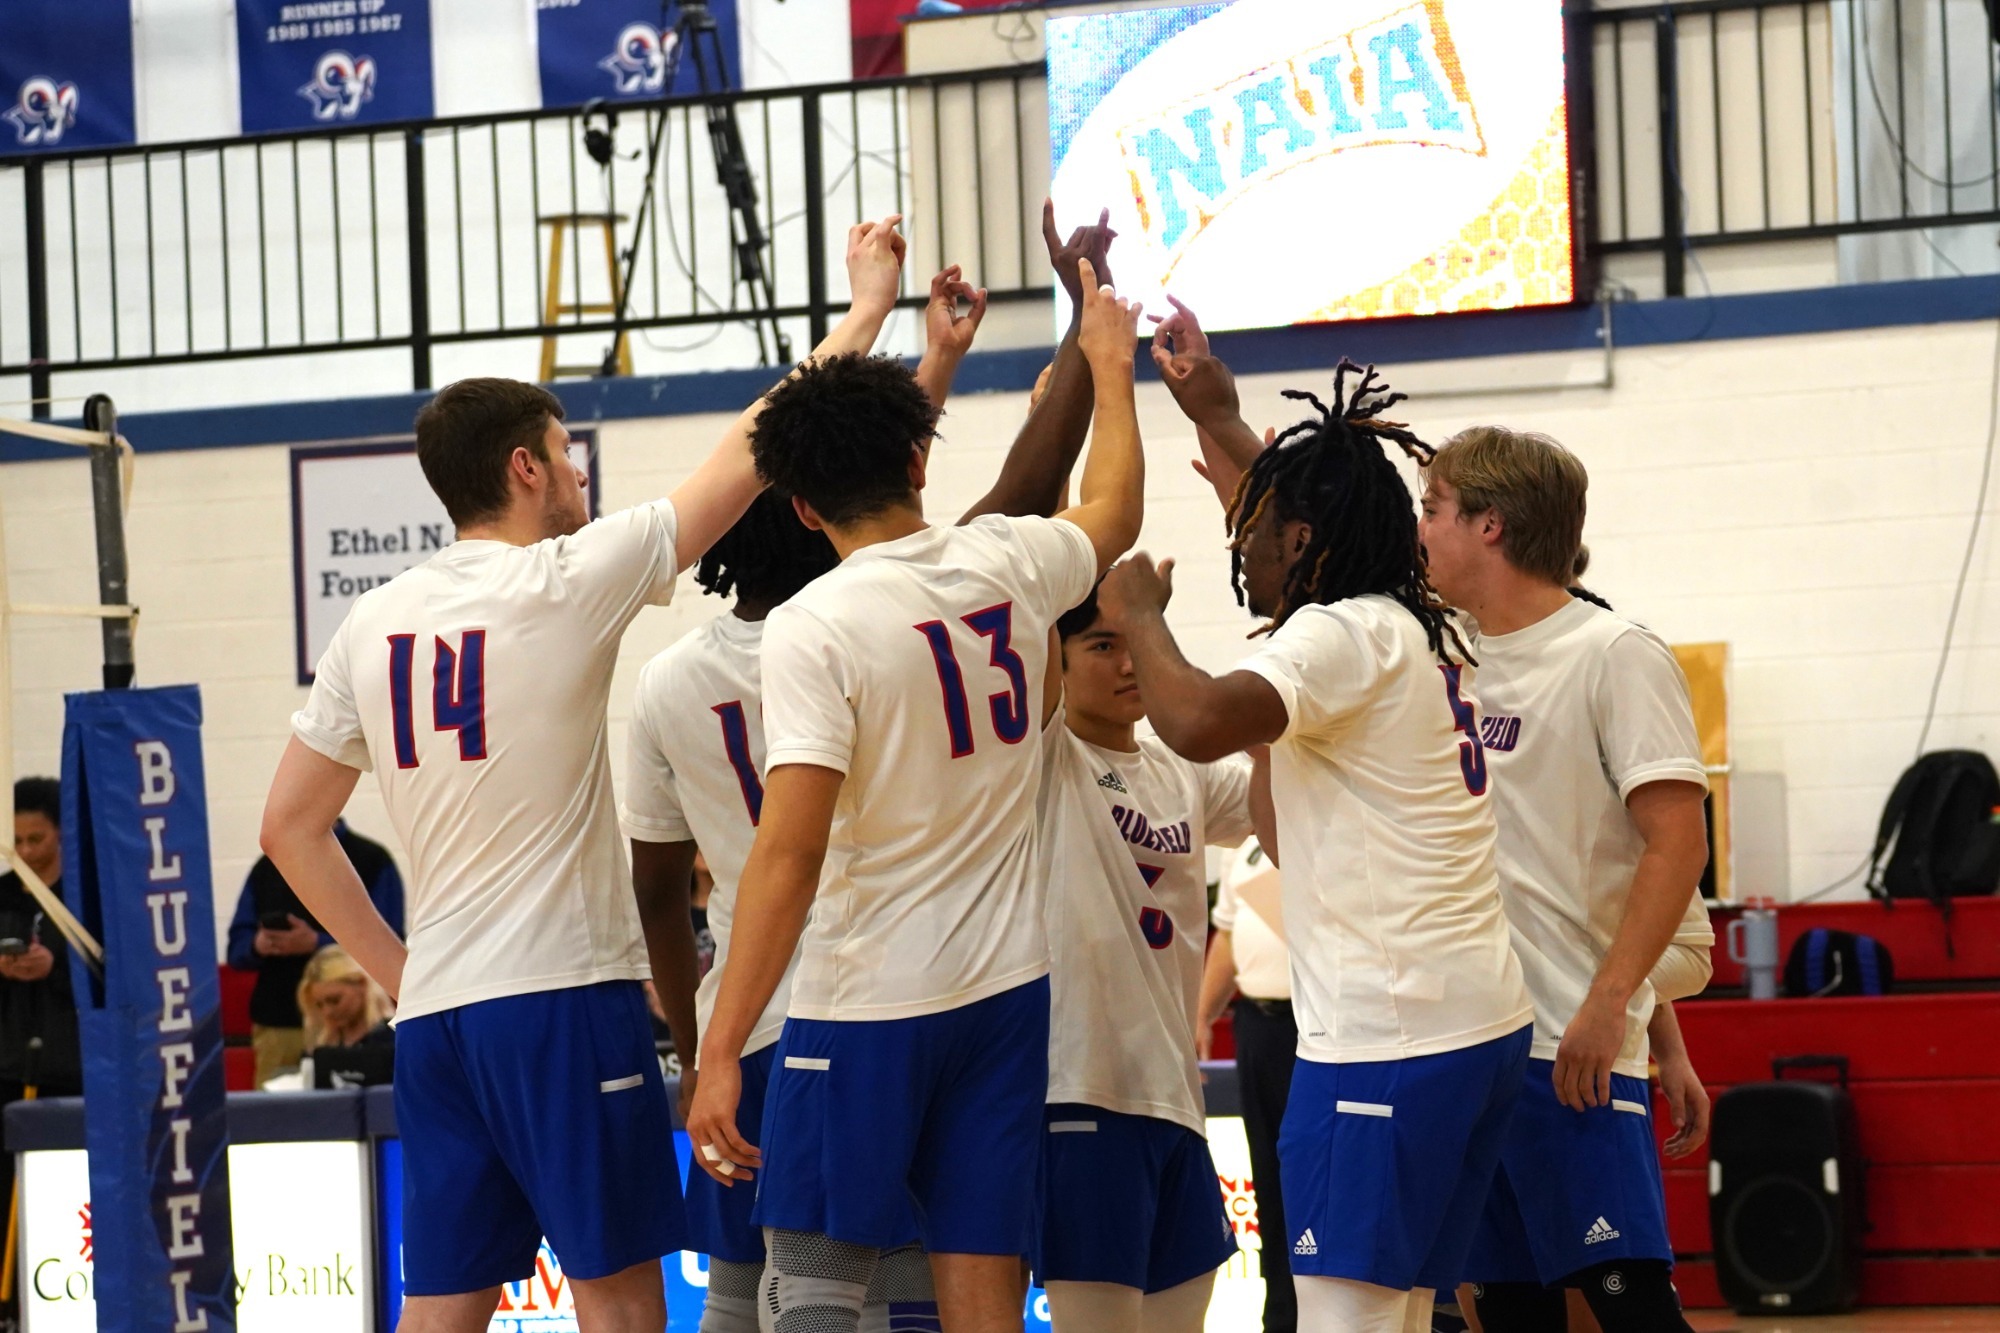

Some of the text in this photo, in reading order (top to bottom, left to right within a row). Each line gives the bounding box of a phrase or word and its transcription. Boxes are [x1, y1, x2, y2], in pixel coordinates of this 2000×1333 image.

[280, 0, 385, 22] RUNNER UP
[1132, 20, 1465, 250] NAIA
[330, 526, 411, 556] Ethel
[912, 601, 1029, 760] 13
[386, 629, 488, 769] 14
[1098, 779, 1127, 794] adidas
[1294, 1244, 1318, 1255] adidas
[1584, 1230, 1620, 1245] adidas
[268, 1252, 355, 1297] Bank
